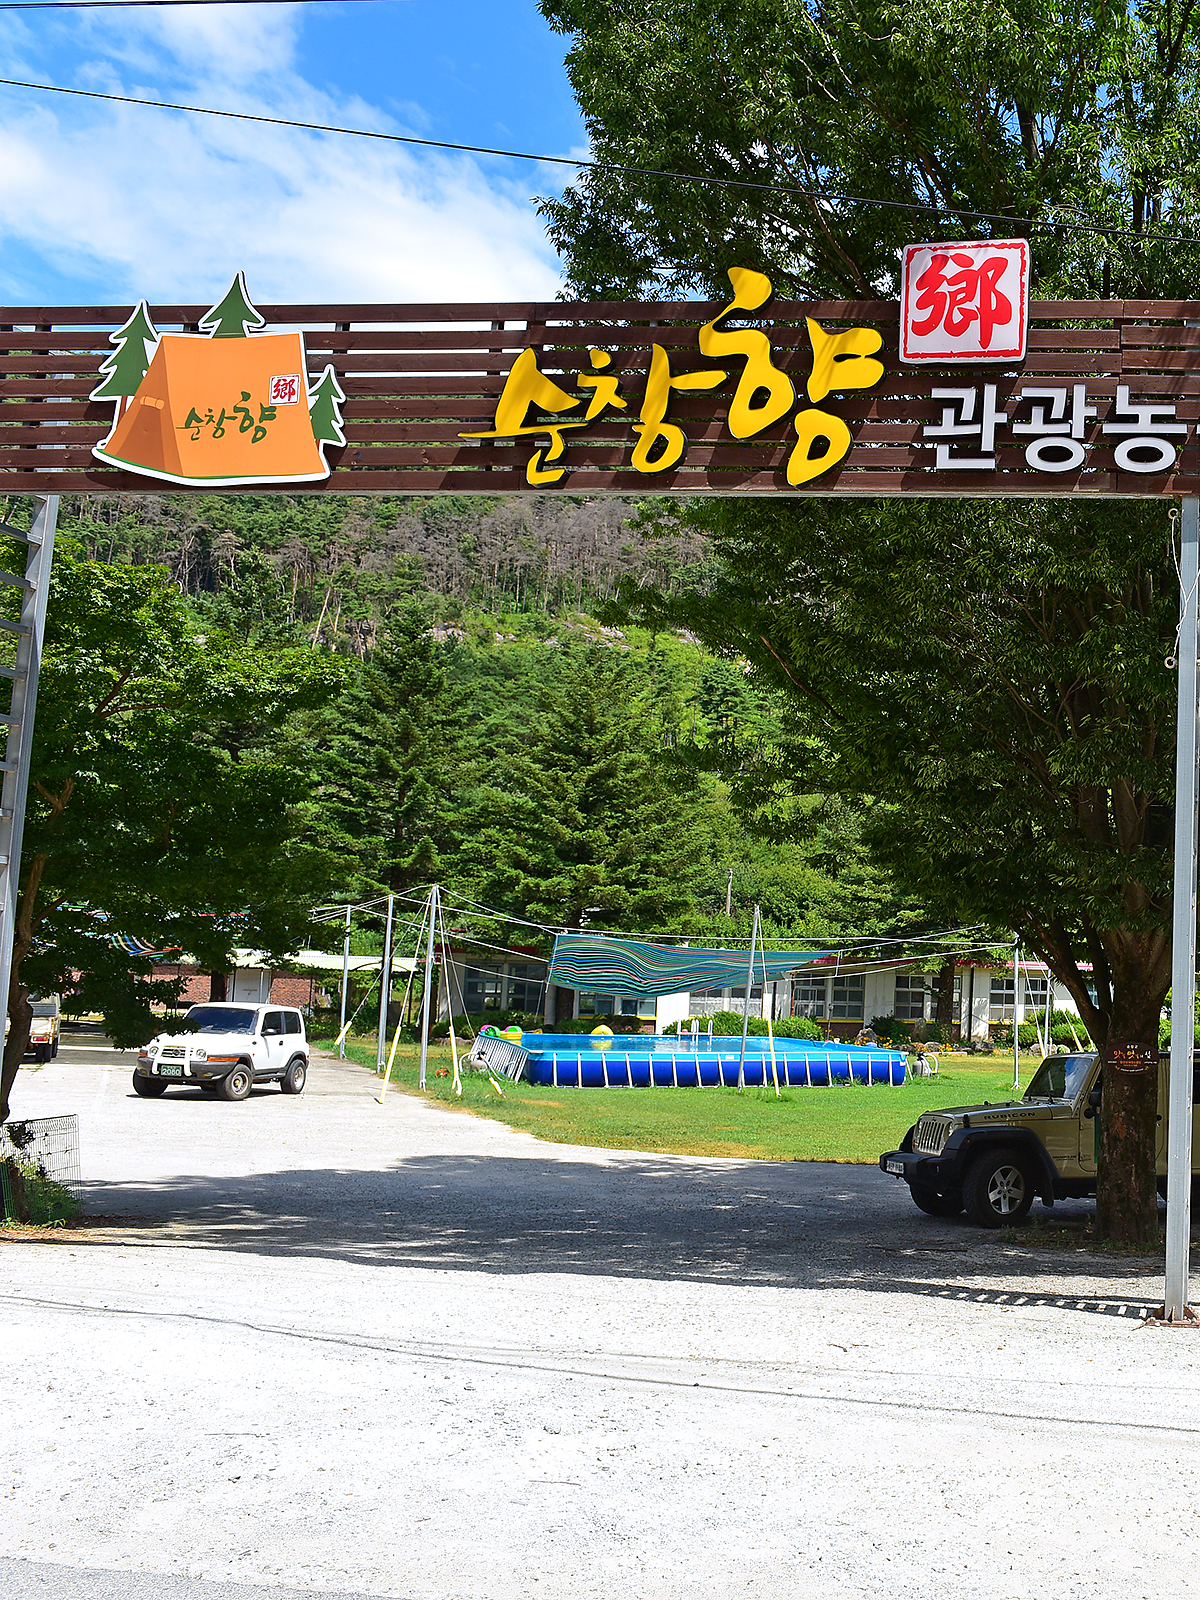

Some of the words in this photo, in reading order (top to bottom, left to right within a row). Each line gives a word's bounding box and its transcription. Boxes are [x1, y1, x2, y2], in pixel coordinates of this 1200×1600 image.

[457, 266, 886, 488] 순창향
[175, 391, 277, 444] 순창향
[983, 1112, 1036, 1120] RUBICON
